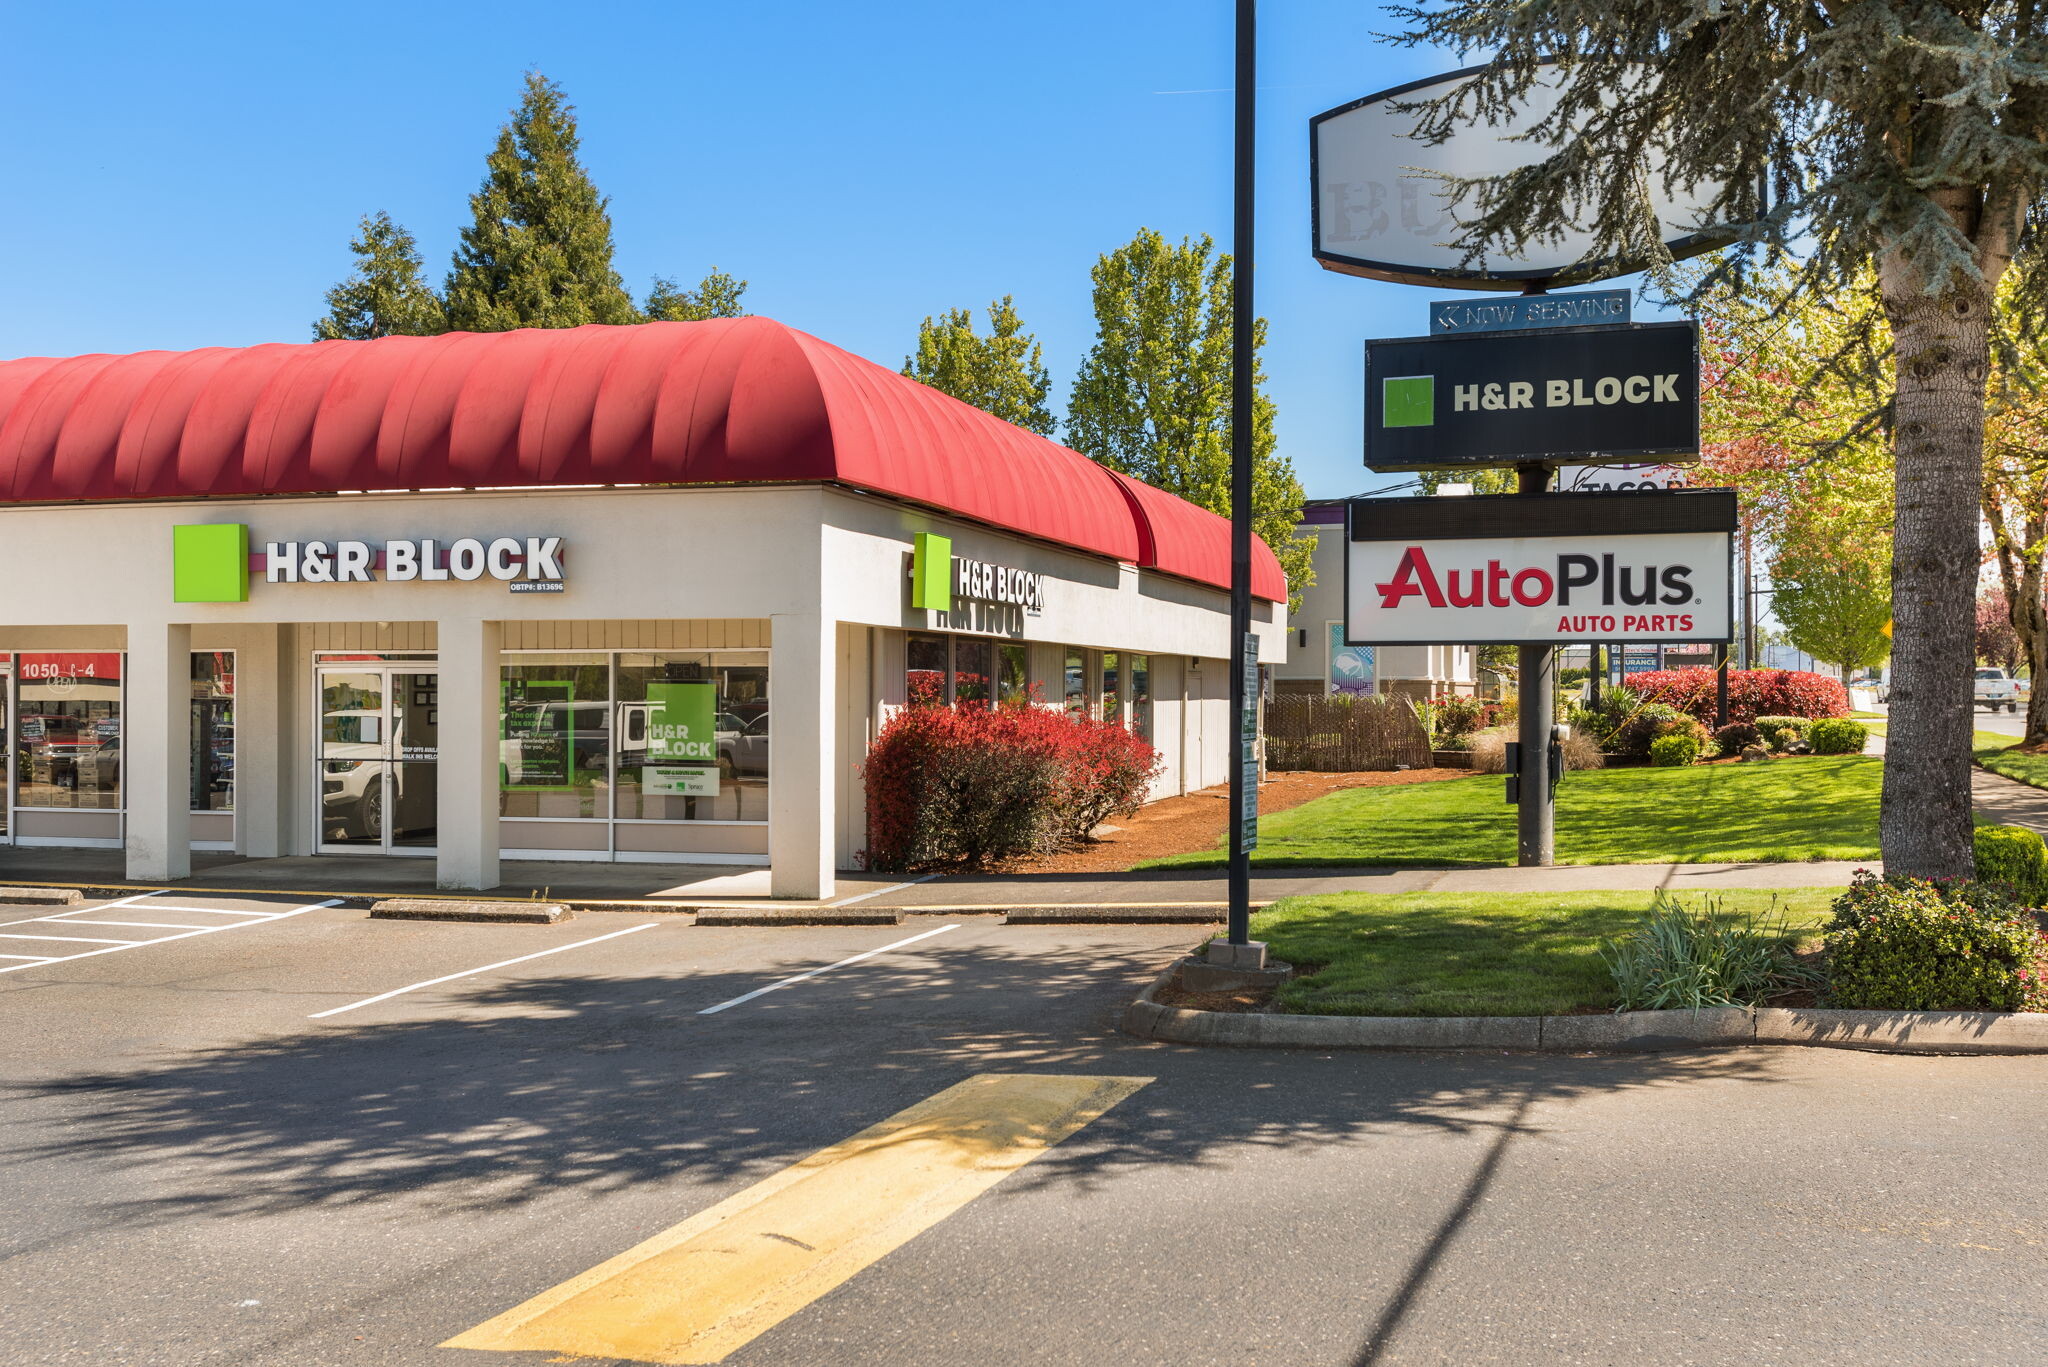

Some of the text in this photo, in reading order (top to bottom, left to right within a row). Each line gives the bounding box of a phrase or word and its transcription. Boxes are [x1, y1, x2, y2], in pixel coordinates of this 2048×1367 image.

[1466, 297, 1622, 324] NOW SERVING
[1454, 374, 1680, 412] H&R BLOCK
[266, 537, 567, 583] H&R BLOCK
[537, 583, 563, 591] B13696
[959, 557, 1044, 607] H&R BLOCK
[1375, 545, 1694, 608] AutoPlus
[1557, 614, 1693, 632] AUTO PARTS
[23, 663, 59, 677] 1050
[652, 723, 689, 739] H&R
[652, 741, 711, 757] BLOCK
